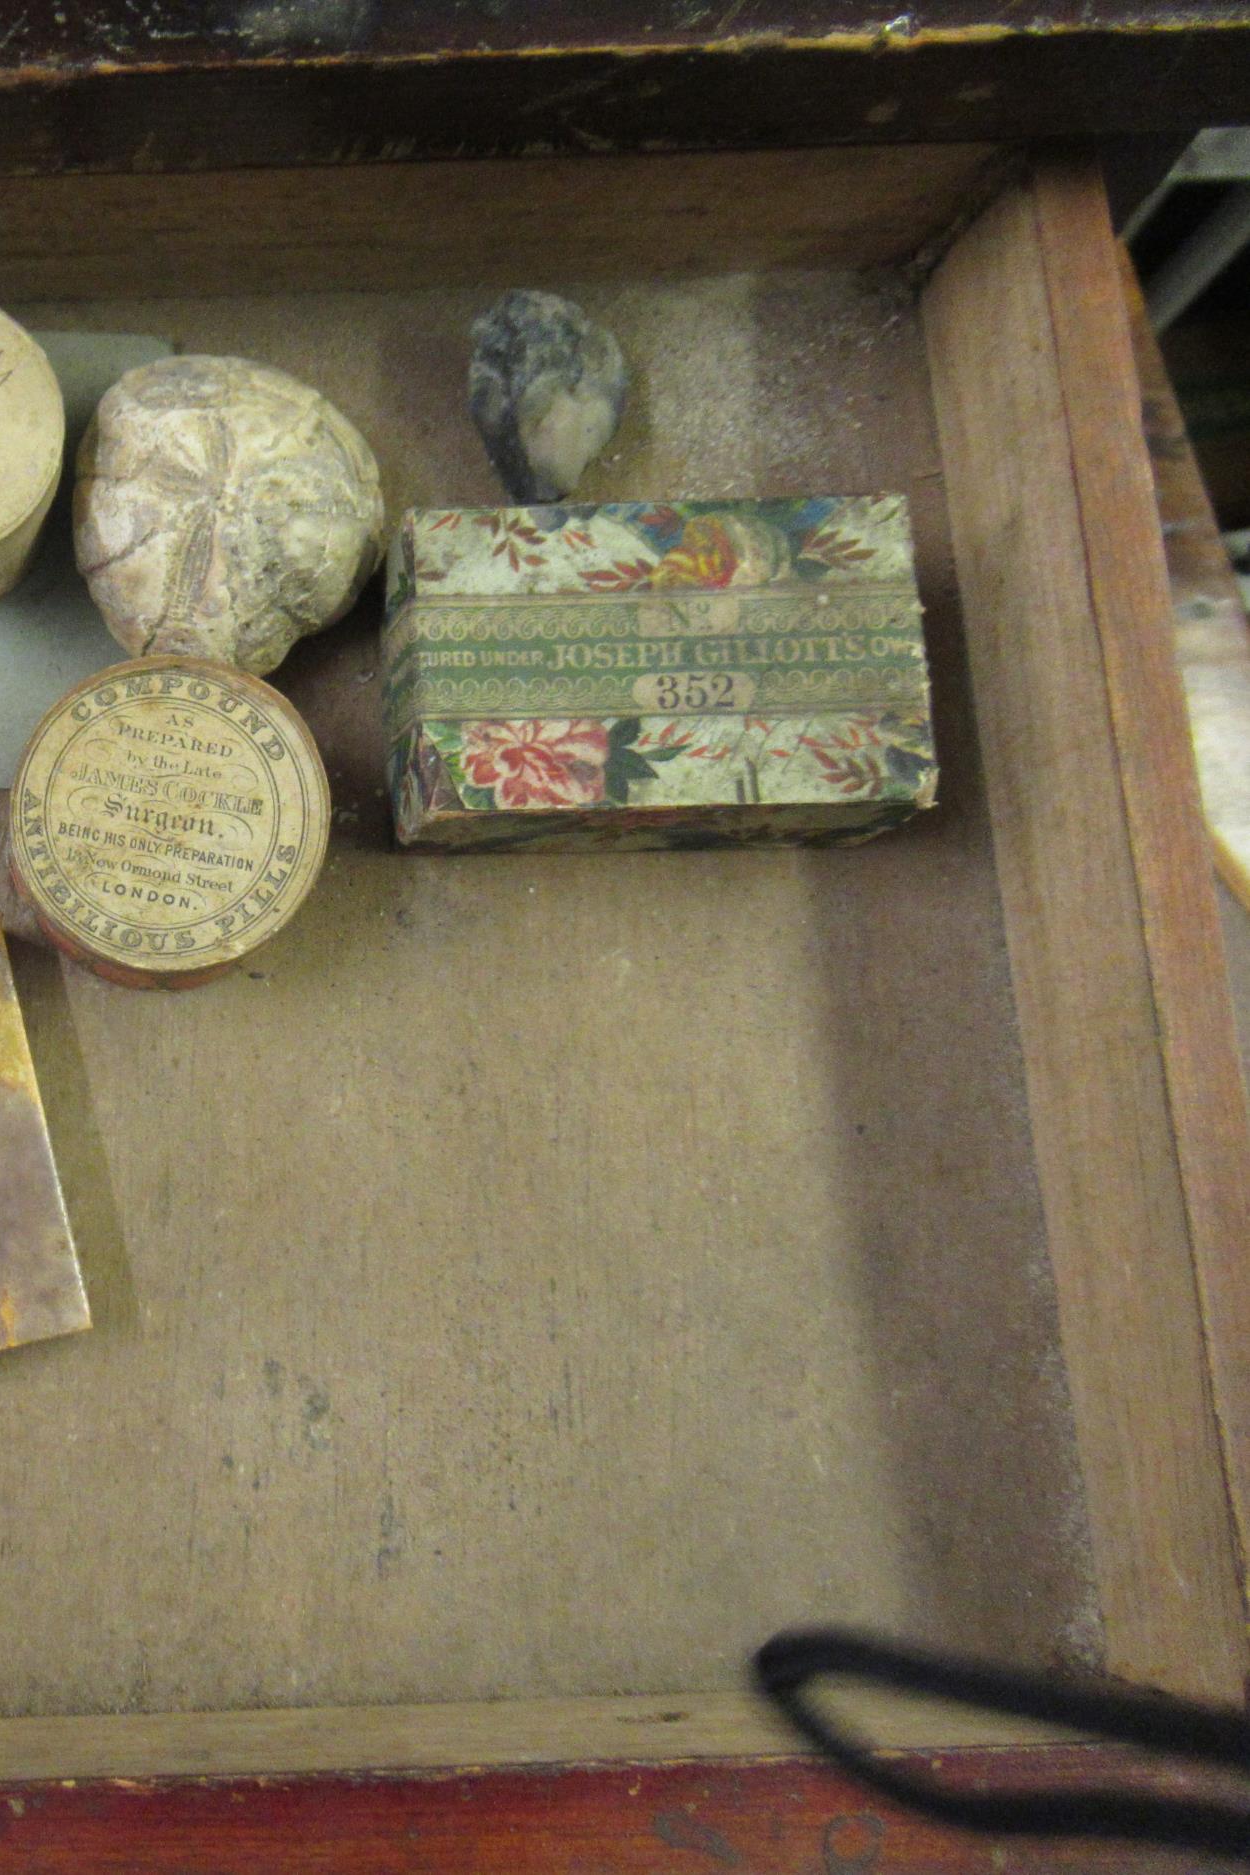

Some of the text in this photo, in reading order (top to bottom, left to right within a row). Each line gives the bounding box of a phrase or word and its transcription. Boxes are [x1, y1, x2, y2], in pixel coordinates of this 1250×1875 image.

[481, 650, 544, 667] UNDER
[547, 642, 682, 671] JOSEPH
[656, 673, 735, 709] 352
[71, 676, 286, 762] COMPOUND
[165, 712, 195, 729] AS
[118, 724, 234, 758] PREPARED
[127, 749, 223, 781] by the Late
[70, 762, 264, 817] JAMES COCKLE
[101, 791, 225, 840] Surgeon.
[57, 821, 255, 874] BEING HIS ONLY PREPARATION
[23, 786, 297, 951] ANTIBILIOUS PILLS
[85, 852, 118, 873] New
[120, 860, 182, 885] Ormond
[185, 870, 235, 895] Street
[102, 880, 198, 912] LONDON.
